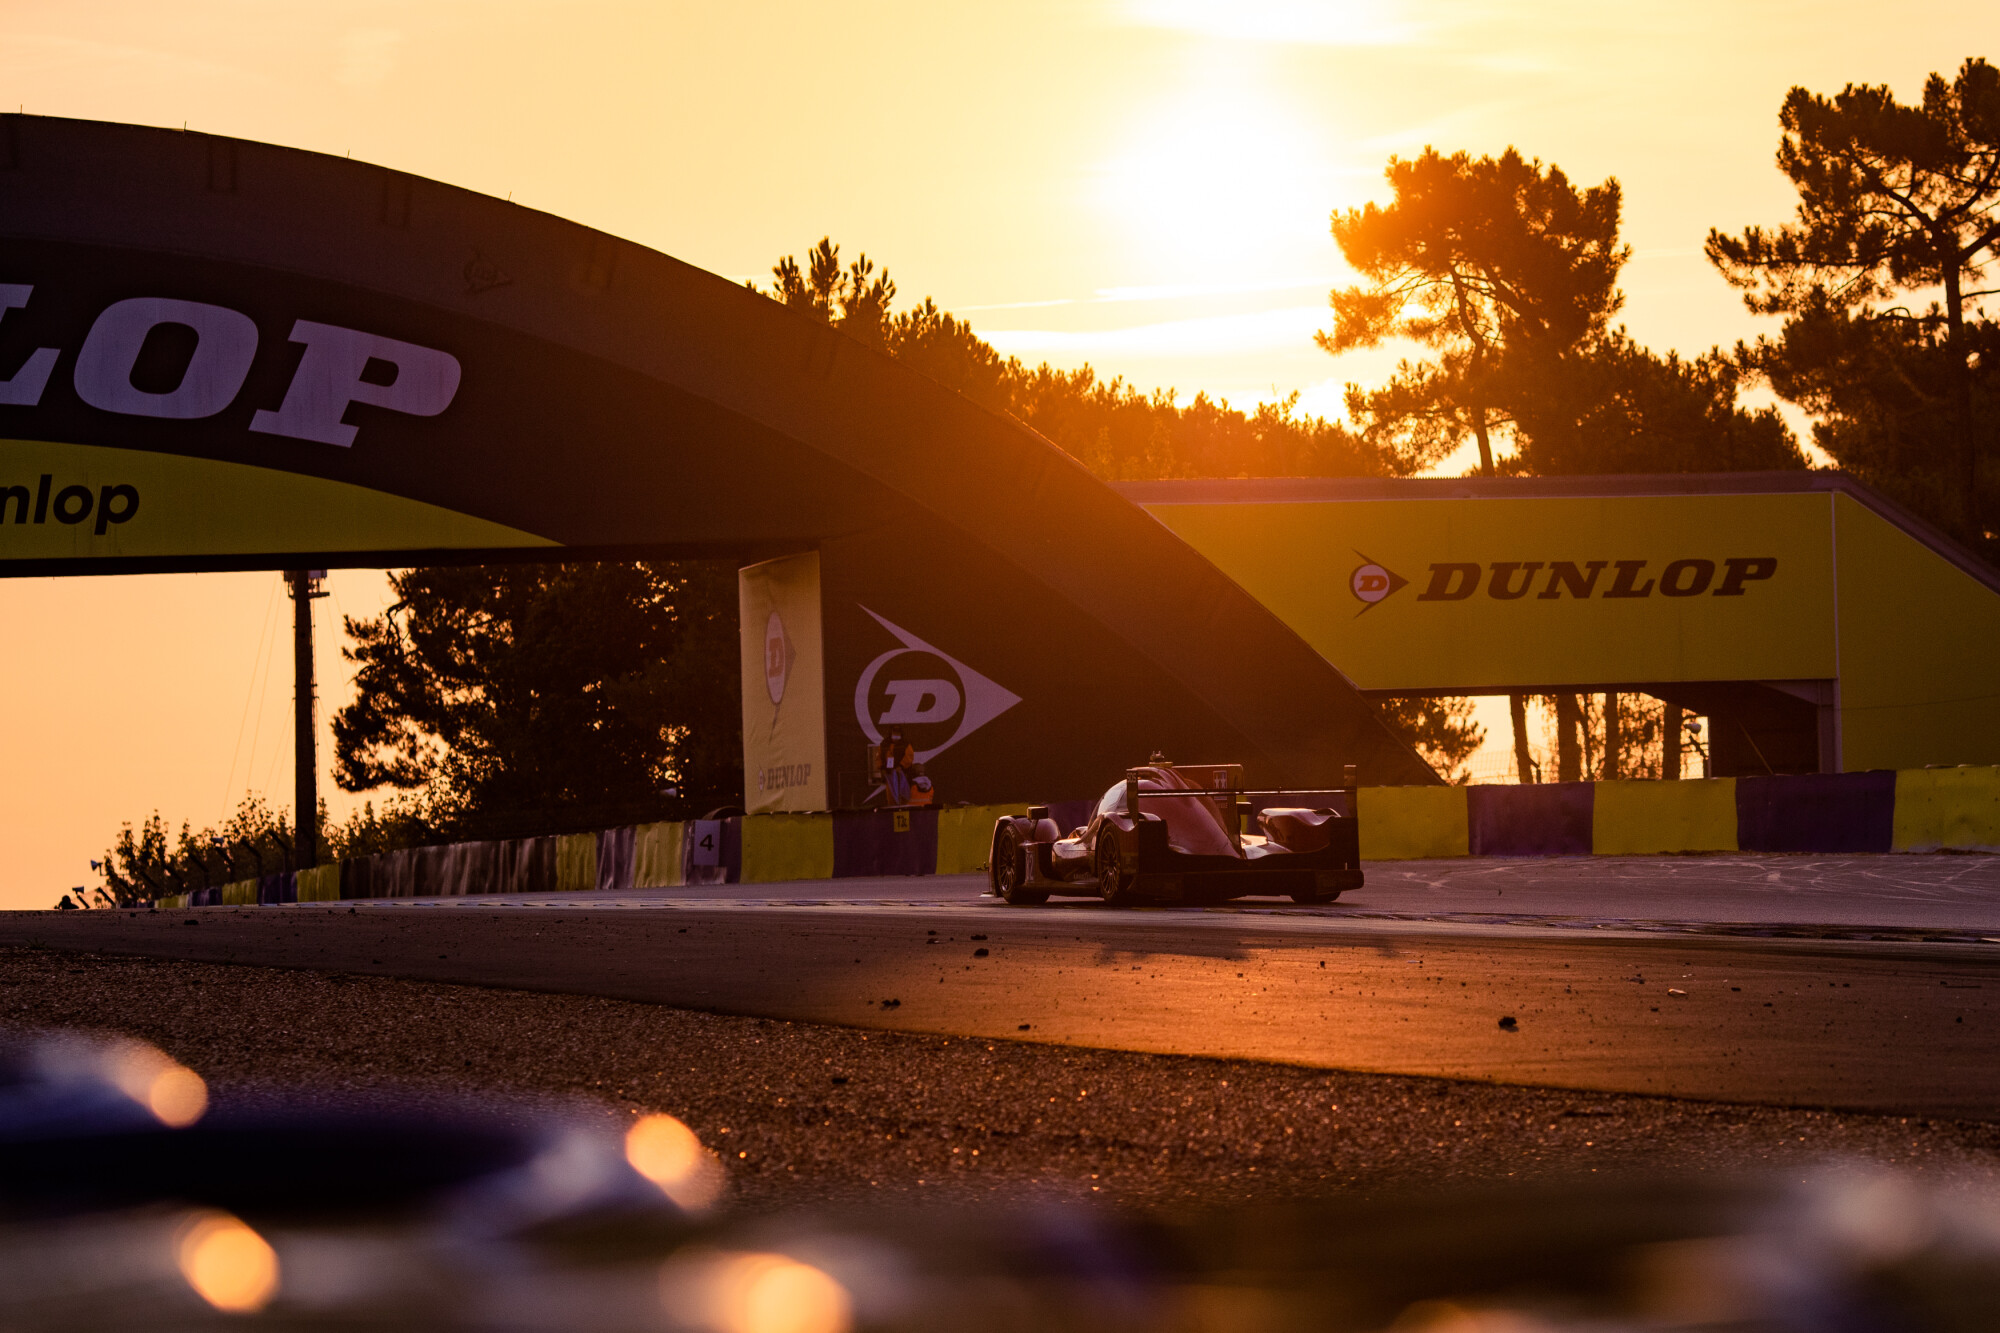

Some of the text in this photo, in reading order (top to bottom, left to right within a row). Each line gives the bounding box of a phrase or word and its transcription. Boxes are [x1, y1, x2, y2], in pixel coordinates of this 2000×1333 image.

[1416, 557, 1777, 602] DUNLOP
[878, 678, 961, 725] D
[766, 763, 811, 791] DUNLOP
[700, 834, 714, 852] 4
